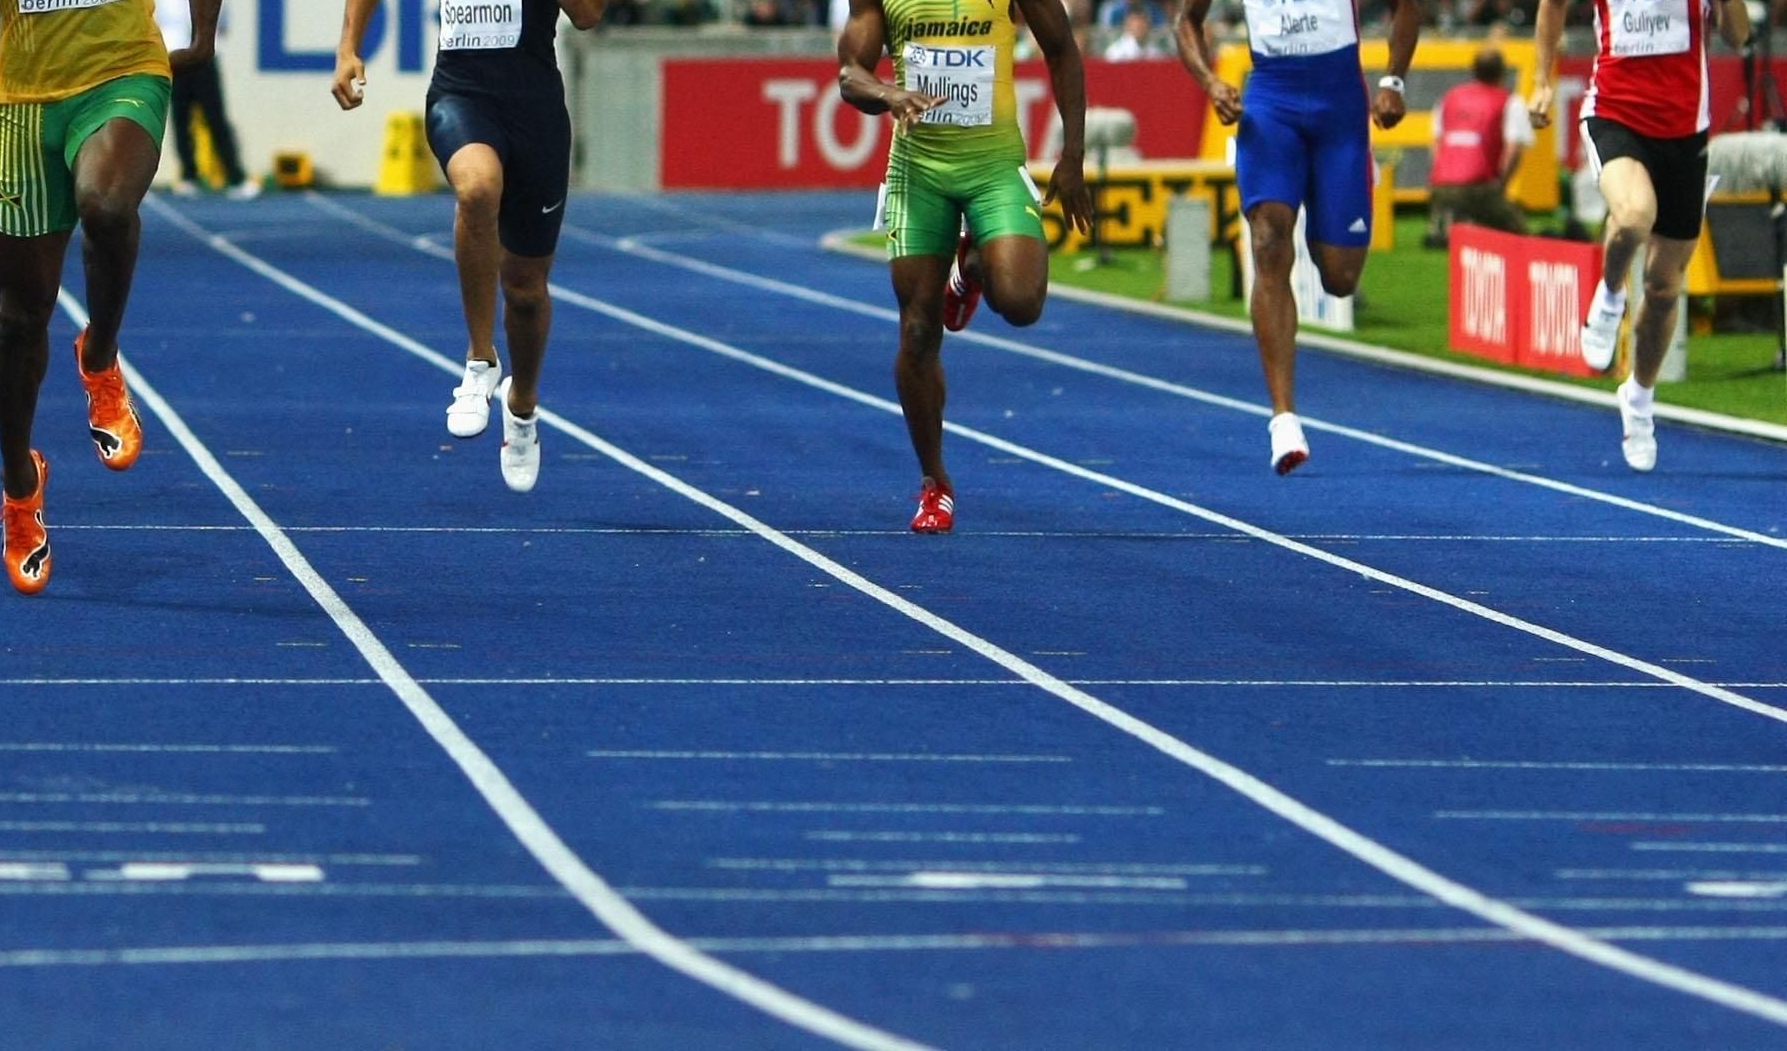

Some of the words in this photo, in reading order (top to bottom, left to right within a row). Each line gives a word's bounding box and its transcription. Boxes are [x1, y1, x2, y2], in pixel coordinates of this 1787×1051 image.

[445, 1, 512, 29] Spearmon
[1624, 11, 1670, 36] Guliyev
[905, 16, 992, 41] jamaica
[926, 49, 985, 67] TDK
[917, 74, 978, 108] Mullings
